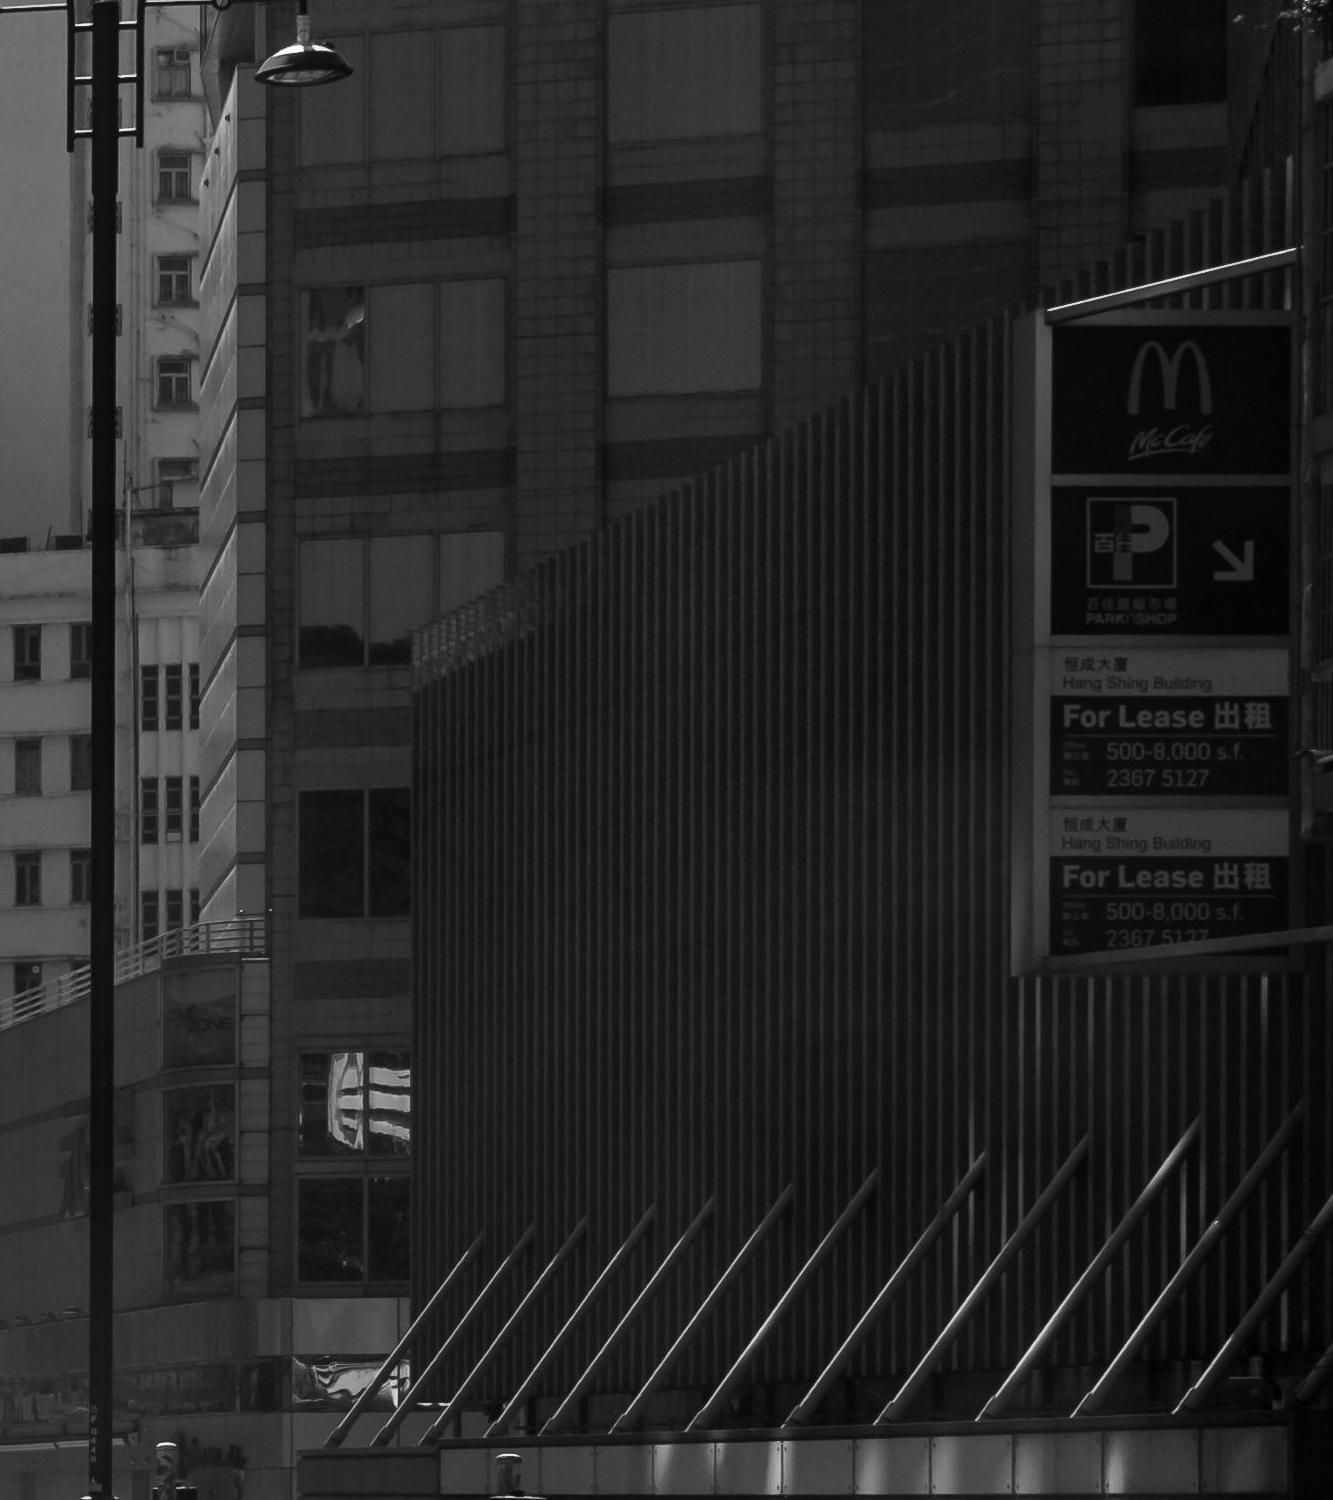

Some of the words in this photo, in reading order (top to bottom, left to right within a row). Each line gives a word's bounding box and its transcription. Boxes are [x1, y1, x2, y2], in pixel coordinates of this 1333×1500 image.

[1062, 676, 1103, 693] Hang
[1106, 676, 1150, 693] Shing
[1153, 675, 1213, 693] Building
[1063, 704, 1111, 729] For
[1118, 704, 1205, 729] Lease
[1213, 701, 1273, 731] 出租
[1217, 742, 1245, 761] s.f.
[1106, 768, 1156, 788] 2367
[1161, 768, 1210, 788] 5127
[1061, 836, 1102, 853] Hang
[1105, 836, 1149, 853] Shing
[1152, 835, 1213, 853] Building
[1062, 864, 1111, 889] For
[1118, 864, 1205, 889] Lease
[1213, 861, 1272, 891] 出租
[1215, 901, 1245, 921] s.f.
[1105, 928, 1156, 948] 2367
